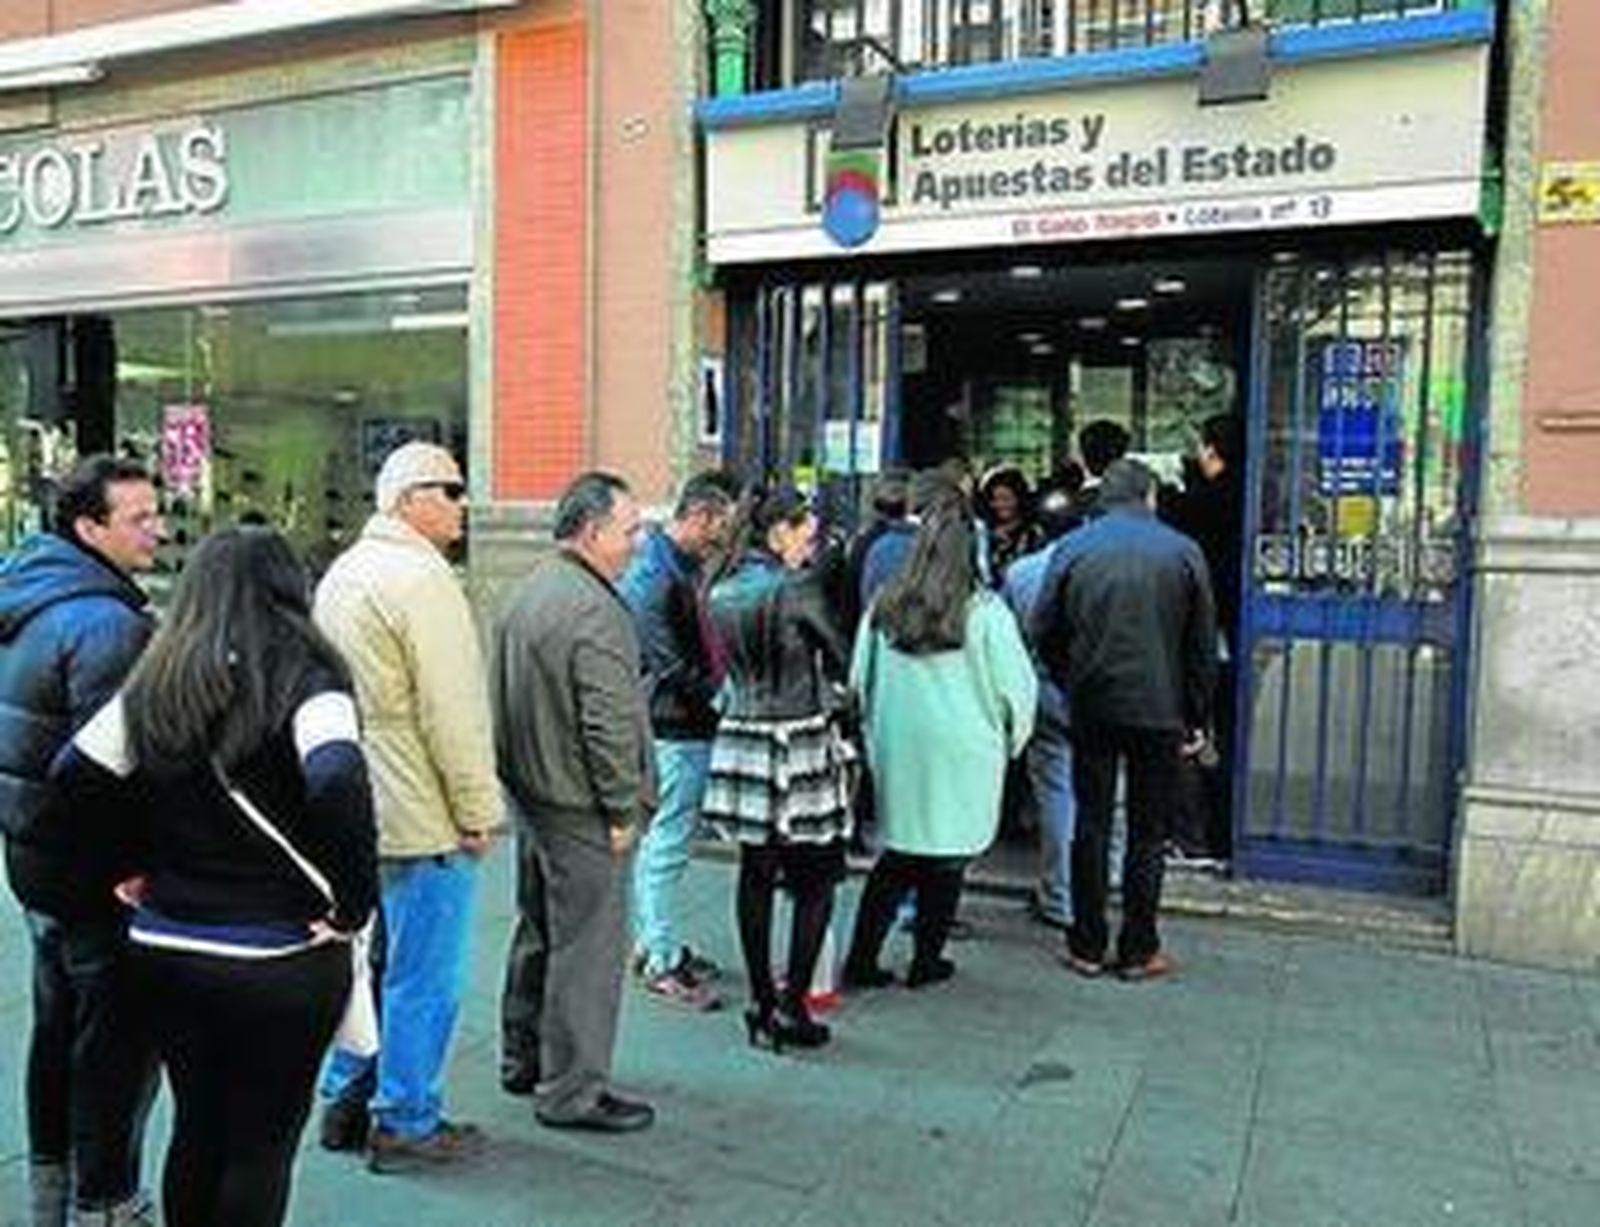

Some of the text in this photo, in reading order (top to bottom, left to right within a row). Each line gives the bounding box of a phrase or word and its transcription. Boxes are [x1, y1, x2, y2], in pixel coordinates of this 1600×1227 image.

[1080, 114, 1105, 152] y
[913, 135, 1337, 209] Apuestas del Estado
